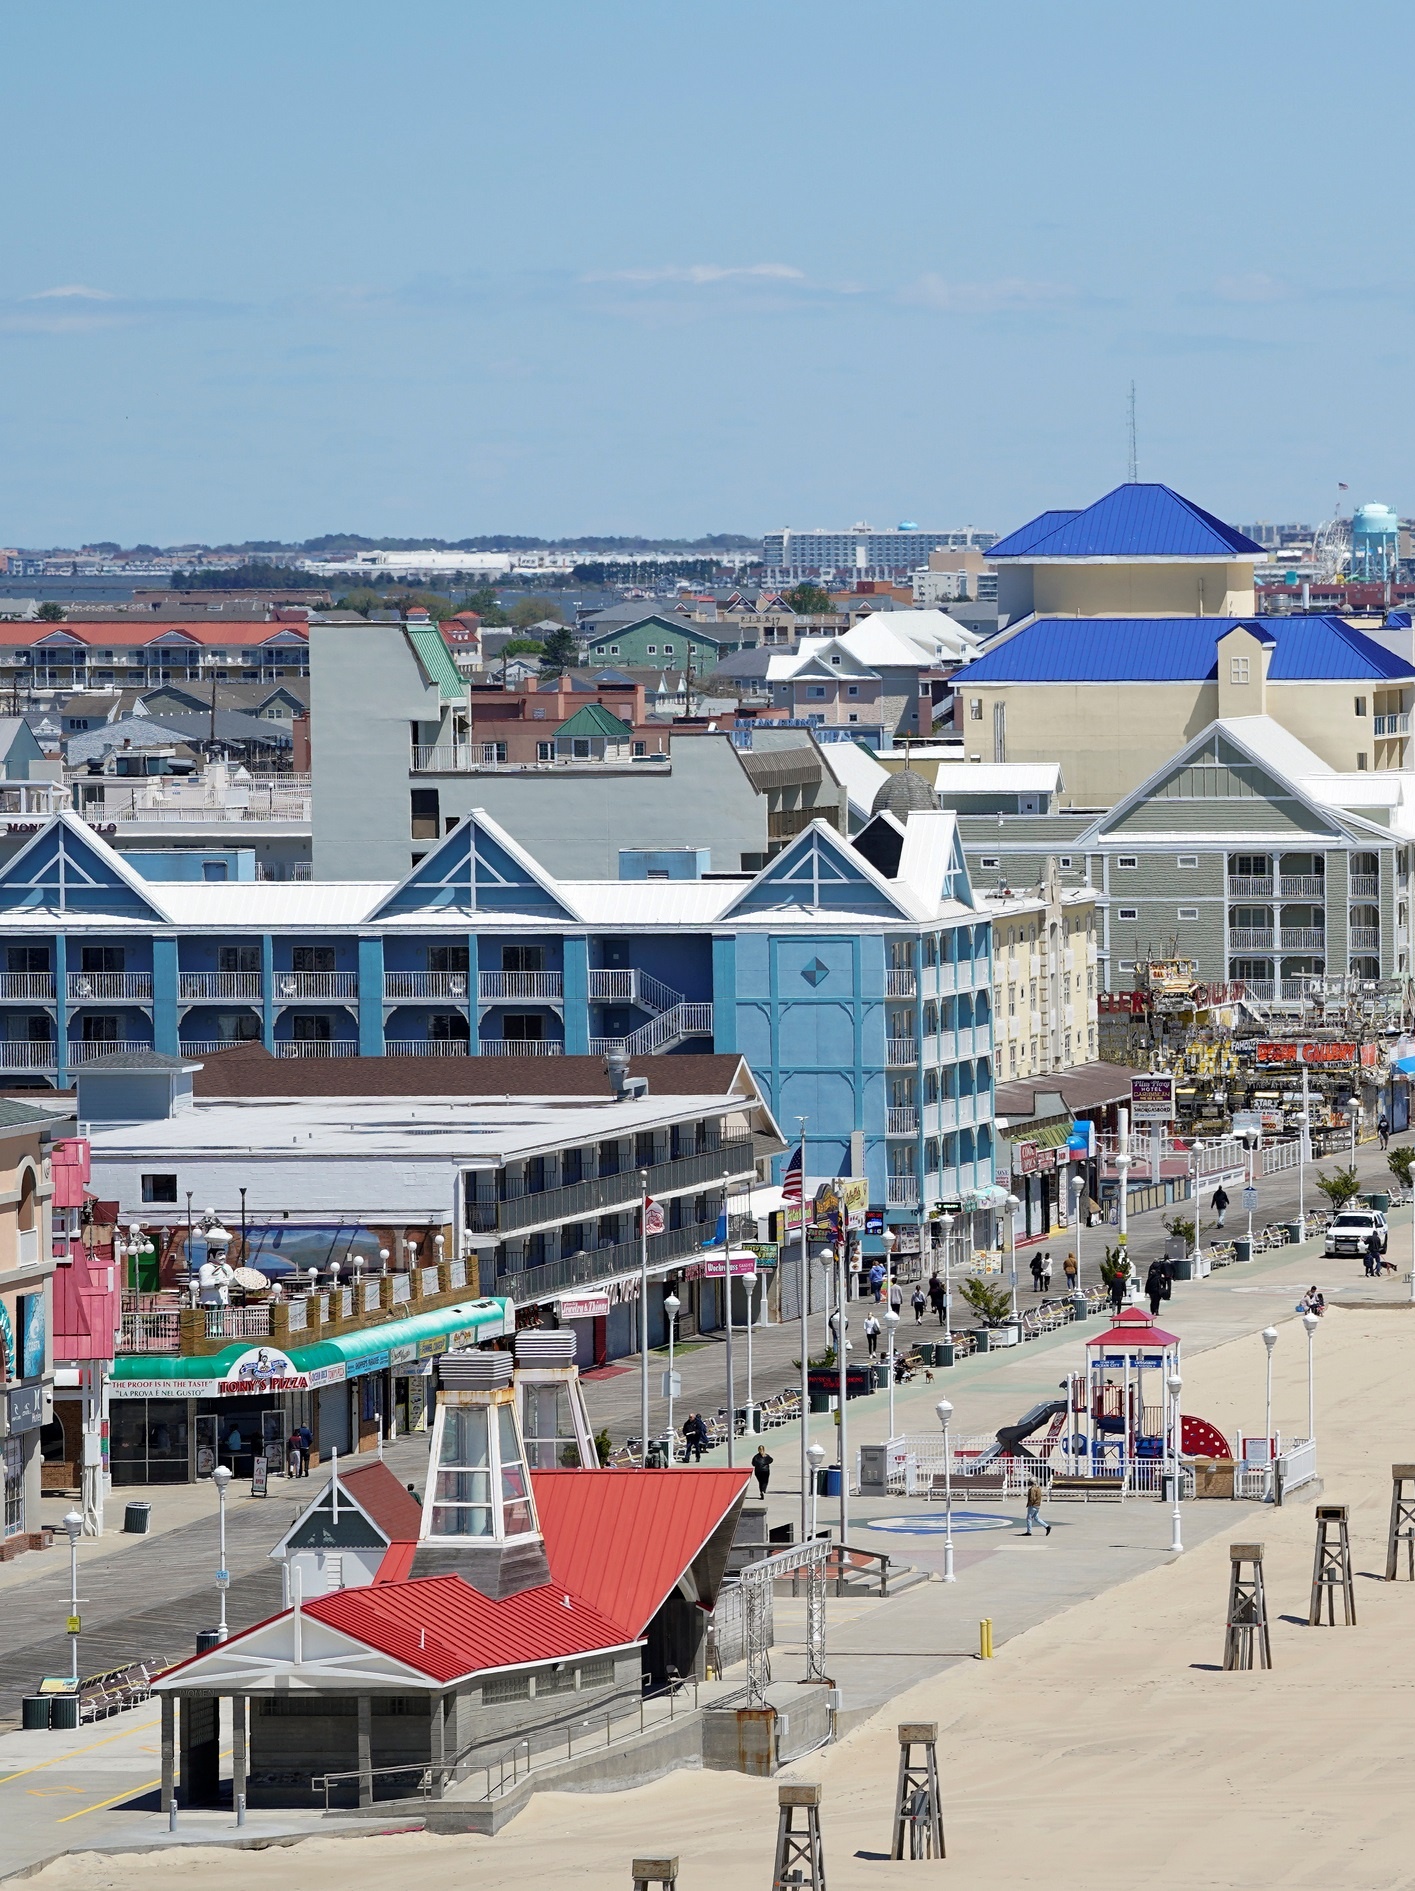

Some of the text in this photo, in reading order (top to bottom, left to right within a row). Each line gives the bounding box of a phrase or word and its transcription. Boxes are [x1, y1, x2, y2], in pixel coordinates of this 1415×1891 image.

[7, 823, 46, 833] MONT
[1302, 1043, 1357, 1062] GALLERY
[708, 1262, 738, 1272] Wockenuss
[563, 1303, 583, 1315] Jewelry
[217, 1380, 266, 1394] TONY'S
[269, 1377, 308, 1392] PIZZA
